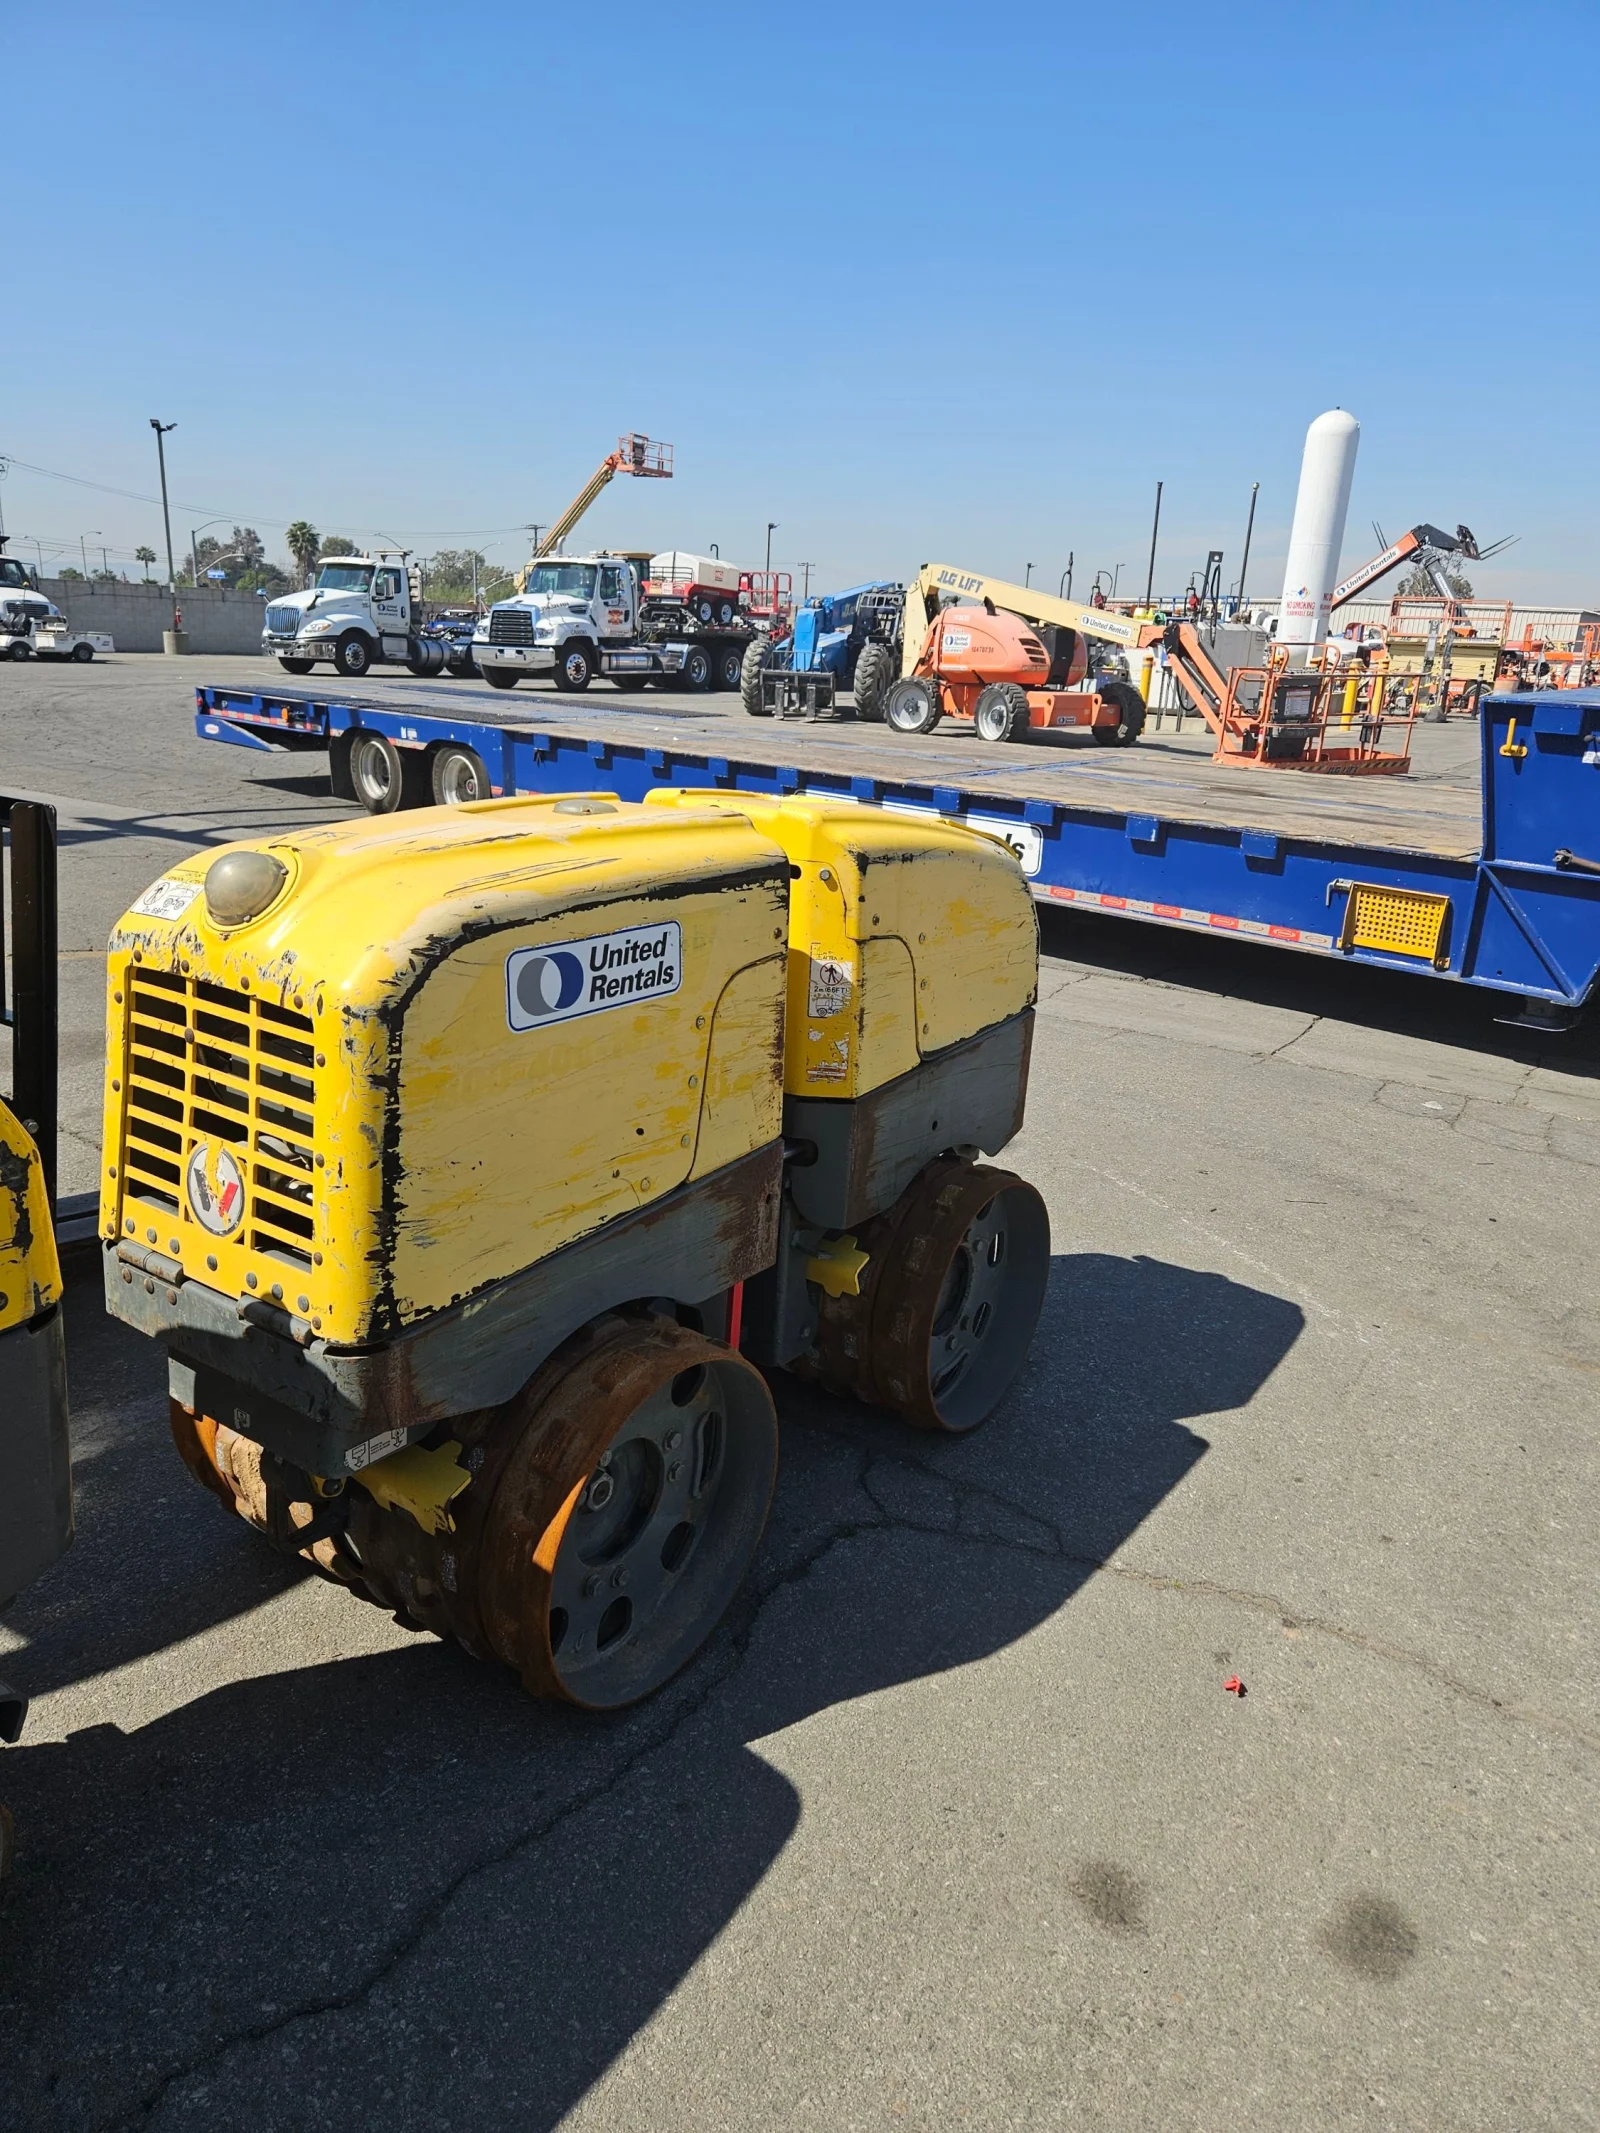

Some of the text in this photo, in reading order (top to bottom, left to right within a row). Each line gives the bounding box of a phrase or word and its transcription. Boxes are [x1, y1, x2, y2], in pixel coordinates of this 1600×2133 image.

[937, 570, 984, 593] JLG LIFT
[1346, 549, 1397, 589] United Rentals
[1292, 601, 1316, 610] SMOKING
[1090, 619, 1130, 636] United Rentals
[589, 931, 669, 972] United
[589, 961, 674, 1002] Rentals
